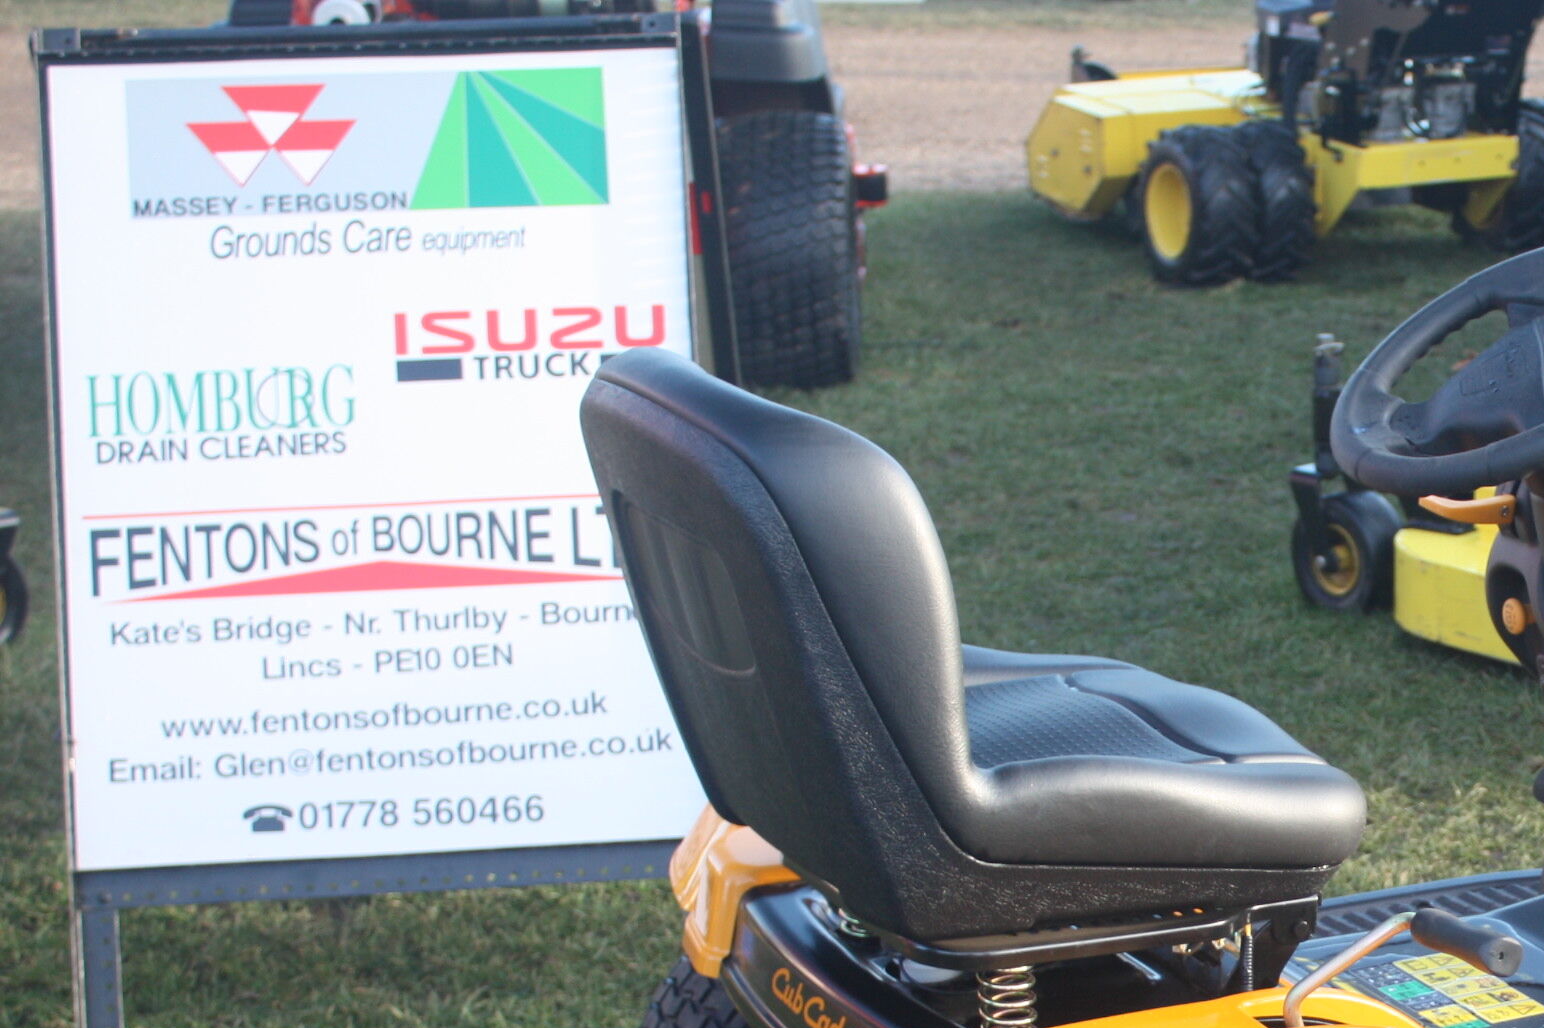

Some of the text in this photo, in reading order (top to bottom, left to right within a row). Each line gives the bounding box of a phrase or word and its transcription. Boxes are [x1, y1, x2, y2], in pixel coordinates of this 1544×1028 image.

[133, 196, 237, 217] MASSEY
[262, 191, 408, 213] FERGUSON
[210, 219, 526, 259] Grounds Care equipment
[394, 304, 666, 355] ISUZU
[474, 352, 591, 380] TRUCK
[86, 363, 357, 438] HOMBURG
[96, 431, 347, 465] DRAIN CLEANERS
[90, 519, 320, 597] FENTONS
[331, 518, 359, 556] of
[372, 507, 554, 563] BOURNE
[110, 619, 201, 646] Kate's
[213, 615, 311, 645] Bridge
[344, 609, 381, 635] Nr.
[393, 606, 508, 634] Thurlby
[262, 655, 342, 680] Lincs
[374, 647, 441, 674] PE10
[453, 643, 513, 669] 0EN
[161, 691, 607, 738] www.fentonsofbourne.co.uk
[109, 728, 672, 783] Email: Glen@fentonsofbourne.co.uk
[299, 795, 544, 830] 01778 560466
[771, 967, 804, 1015] Cub
